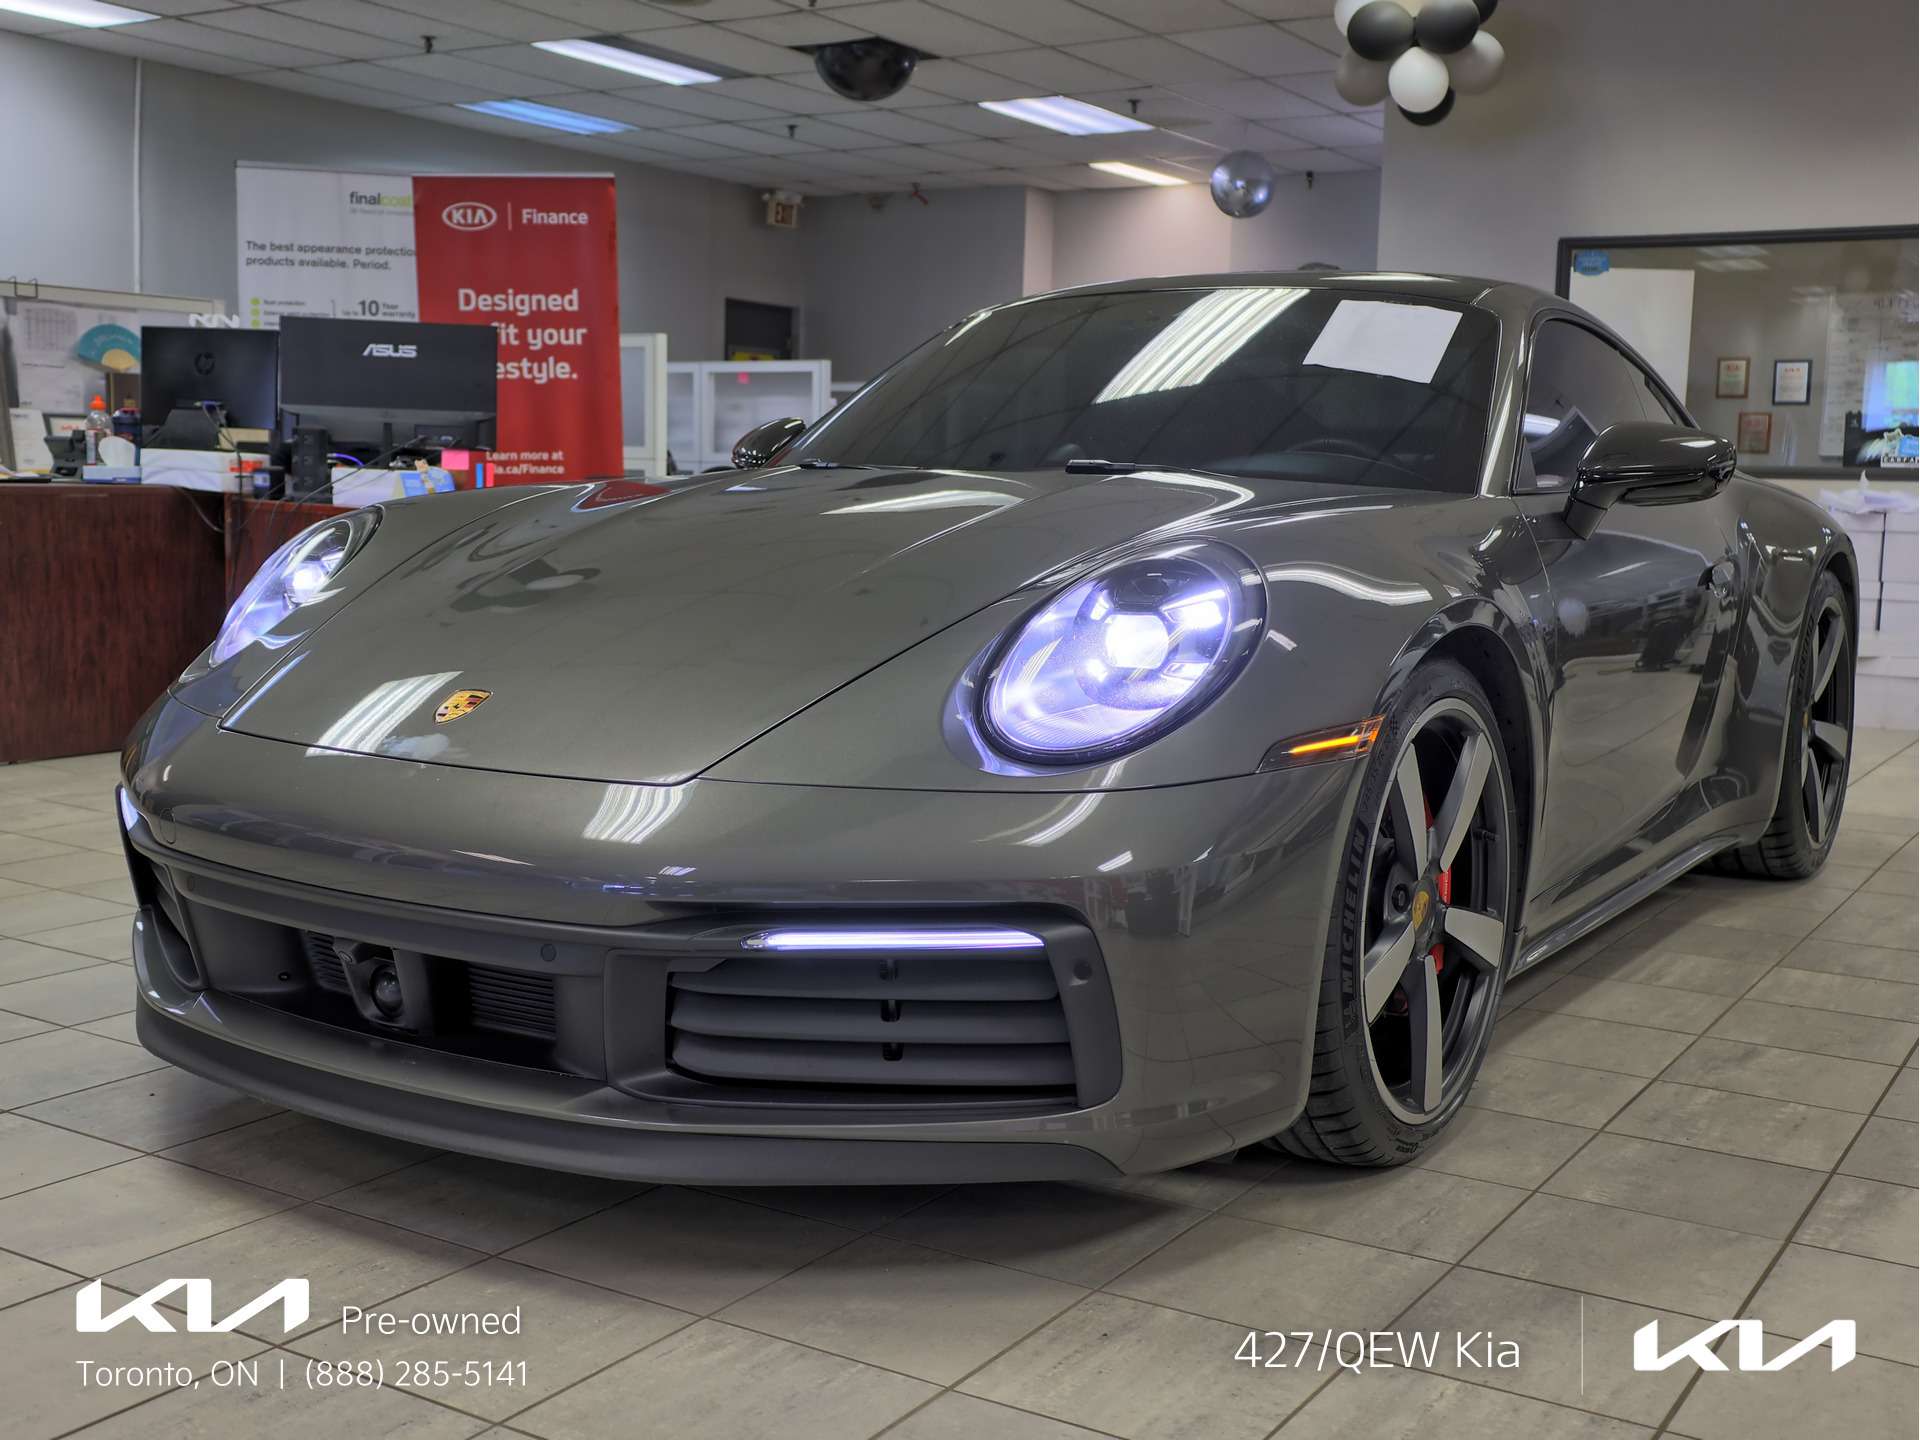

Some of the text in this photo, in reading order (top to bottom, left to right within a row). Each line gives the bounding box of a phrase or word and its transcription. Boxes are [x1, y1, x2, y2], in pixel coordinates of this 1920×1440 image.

[451, 208, 588, 225] KIA Finance
[246, 240, 267, 251] The
[270, 242, 294, 252] best
[297, 245, 361, 255] appearance
[246, 257, 391, 270] products available. Period.
[358, 299, 380, 316] 10
[458, 288, 579, 316] Designed
[527, 328, 588, 350] your
[363, 343, 418, 358] ASUS
[496, 356, 578, 384] estyle.
[486, 450, 564, 461] Learn more at
[494, 463, 565, 475] ia.ca/Finance
[1342, 827, 1367, 995] MICHELIN
